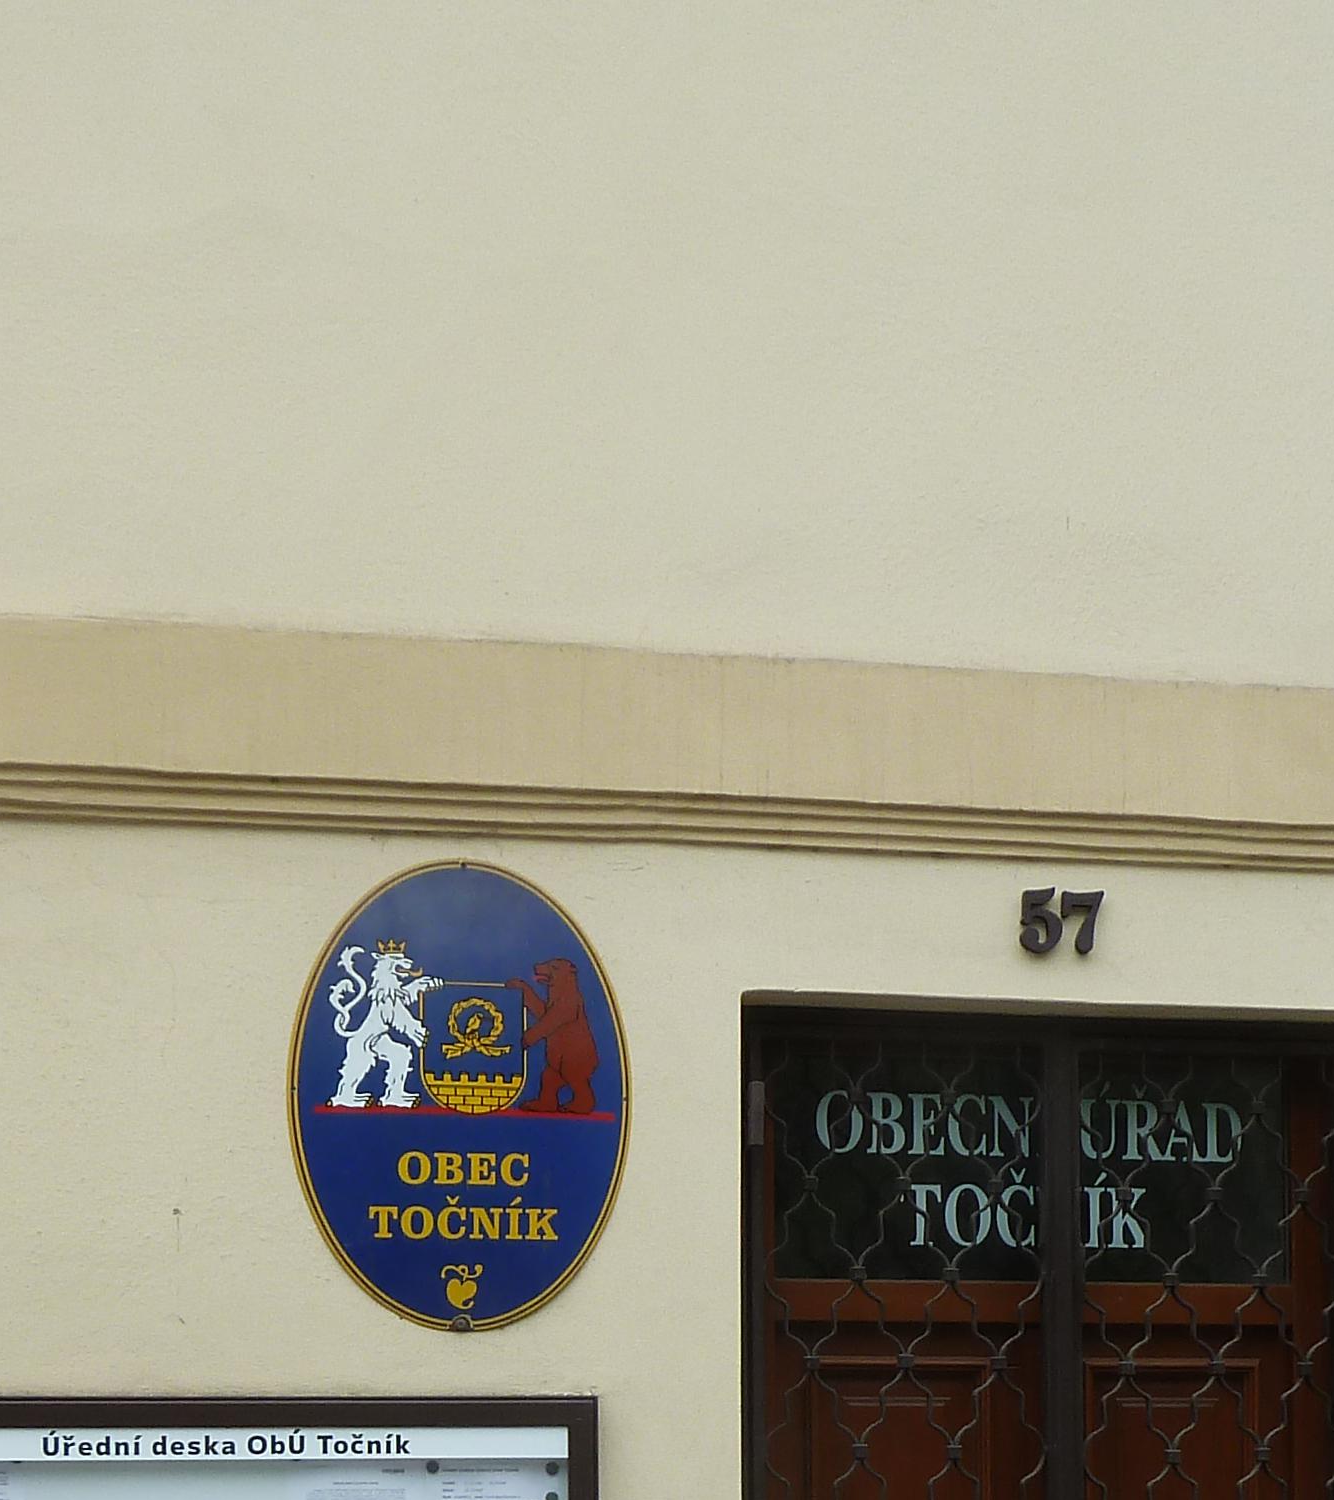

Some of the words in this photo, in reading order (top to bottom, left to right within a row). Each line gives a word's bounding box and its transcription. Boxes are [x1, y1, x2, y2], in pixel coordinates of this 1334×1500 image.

[1019, 886, 1105, 956] 57
[814, 1089, 1036, 1160] OBECN
[396, 1150, 531, 1188] OBEC
[368, 1195, 559, 1241] TOČNÍK
[901, 1168, 1147, 1249] TOČÍK
[42, 1430, 143, 1456] Úřední
[152, 1435, 236, 1456] deska
[247, 1429, 305, 1456] ObÚ
[316, 1432, 411, 1456] Točník
